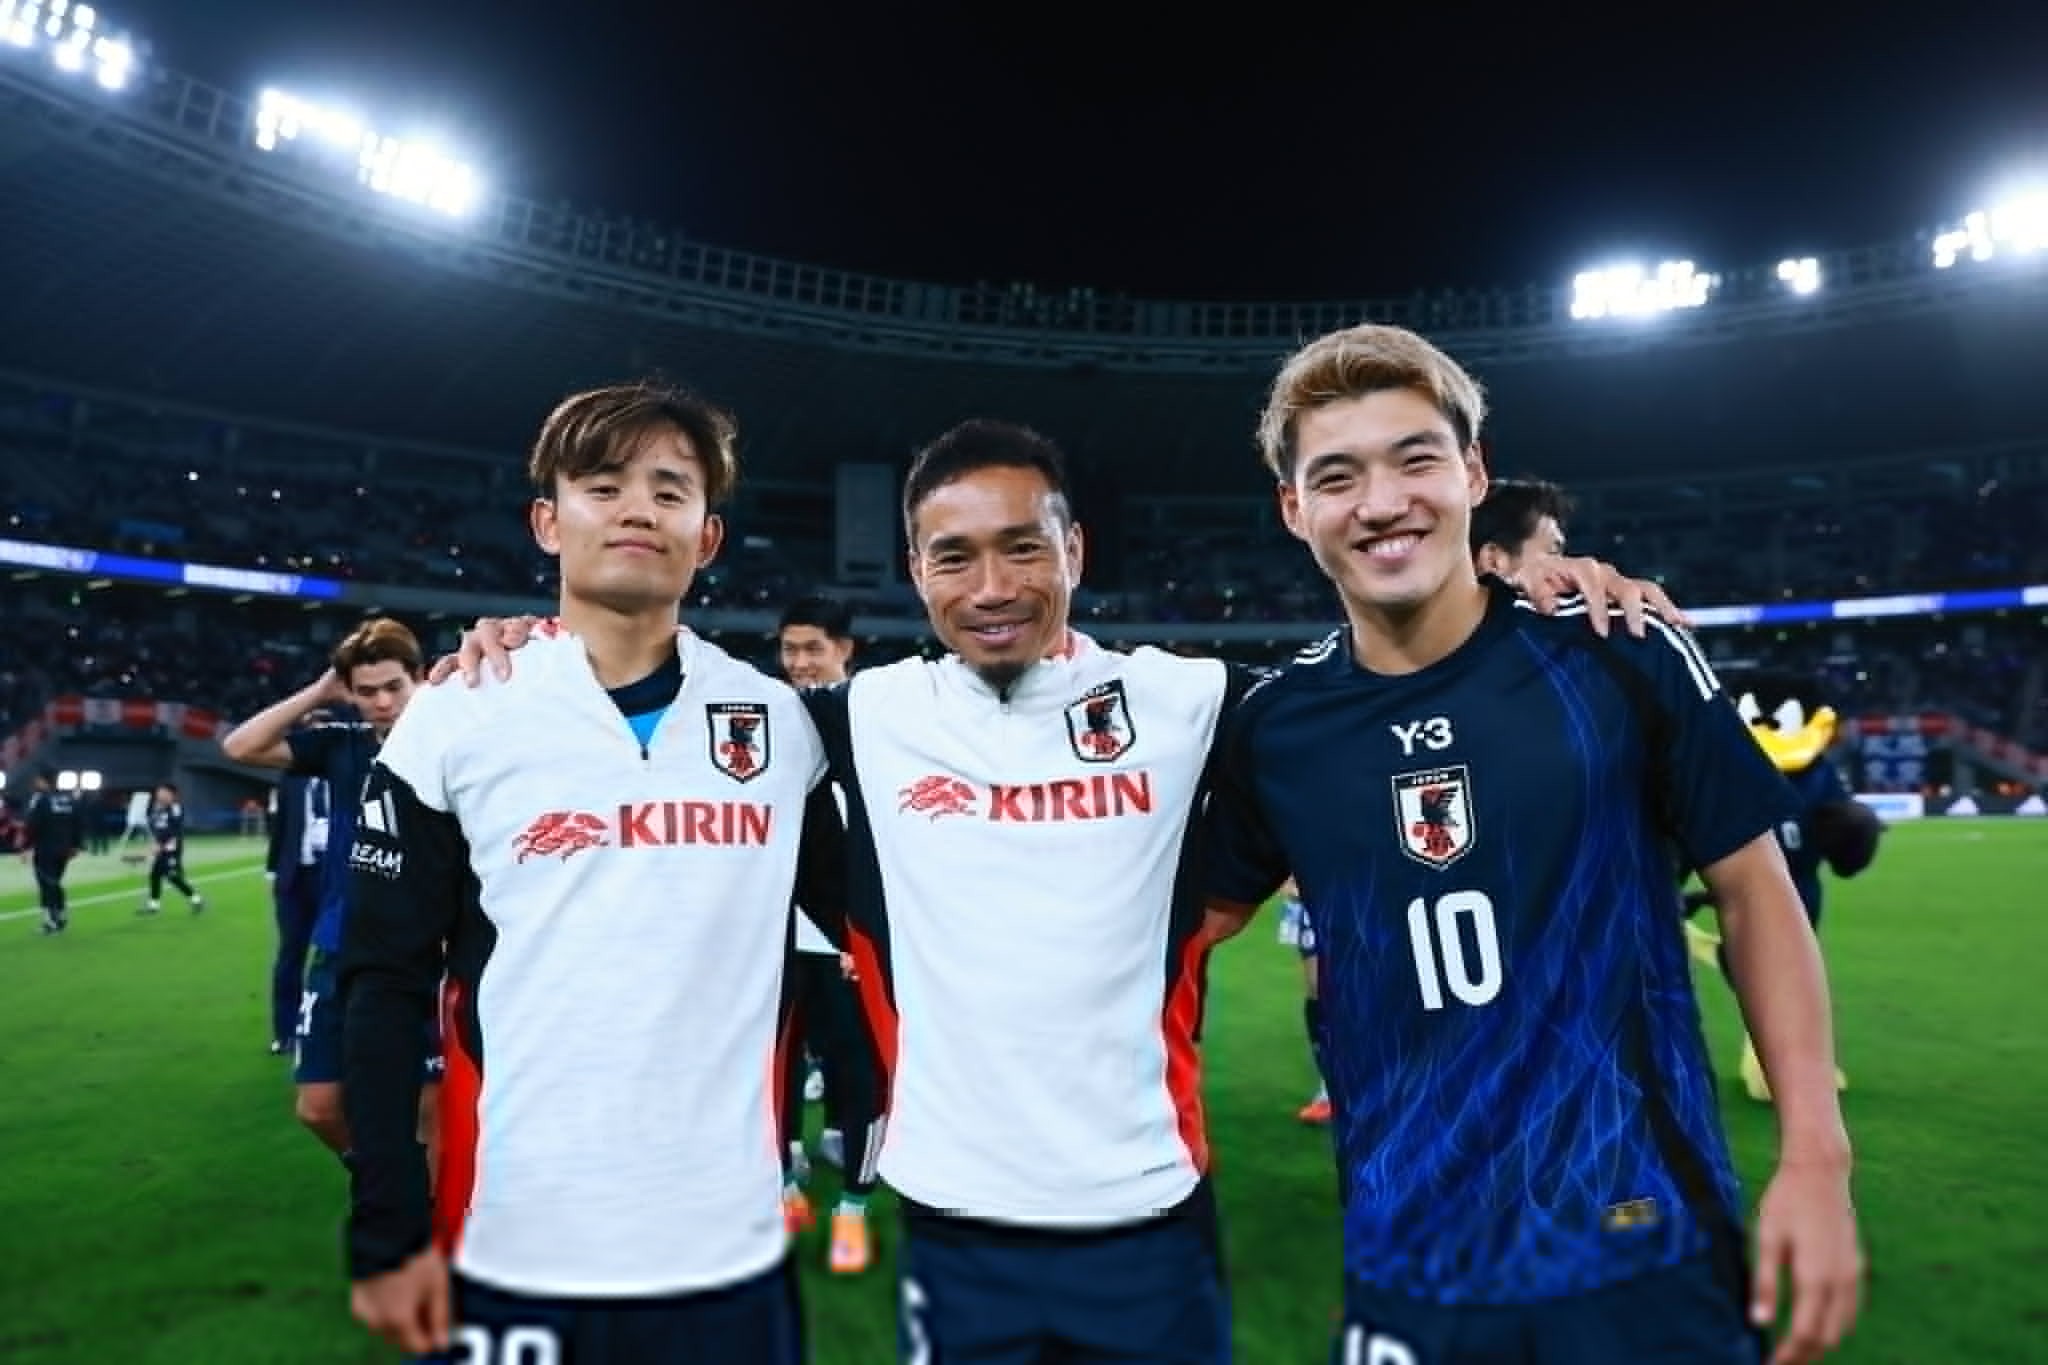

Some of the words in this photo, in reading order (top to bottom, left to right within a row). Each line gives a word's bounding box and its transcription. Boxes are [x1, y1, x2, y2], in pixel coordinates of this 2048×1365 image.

[1391, 716, 1453, 755] Y-3
[987, 770, 1152, 821] KIRIN
[618, 801, 772, 847] KIRIN
[1407, 889, 1503, 1011] 10
